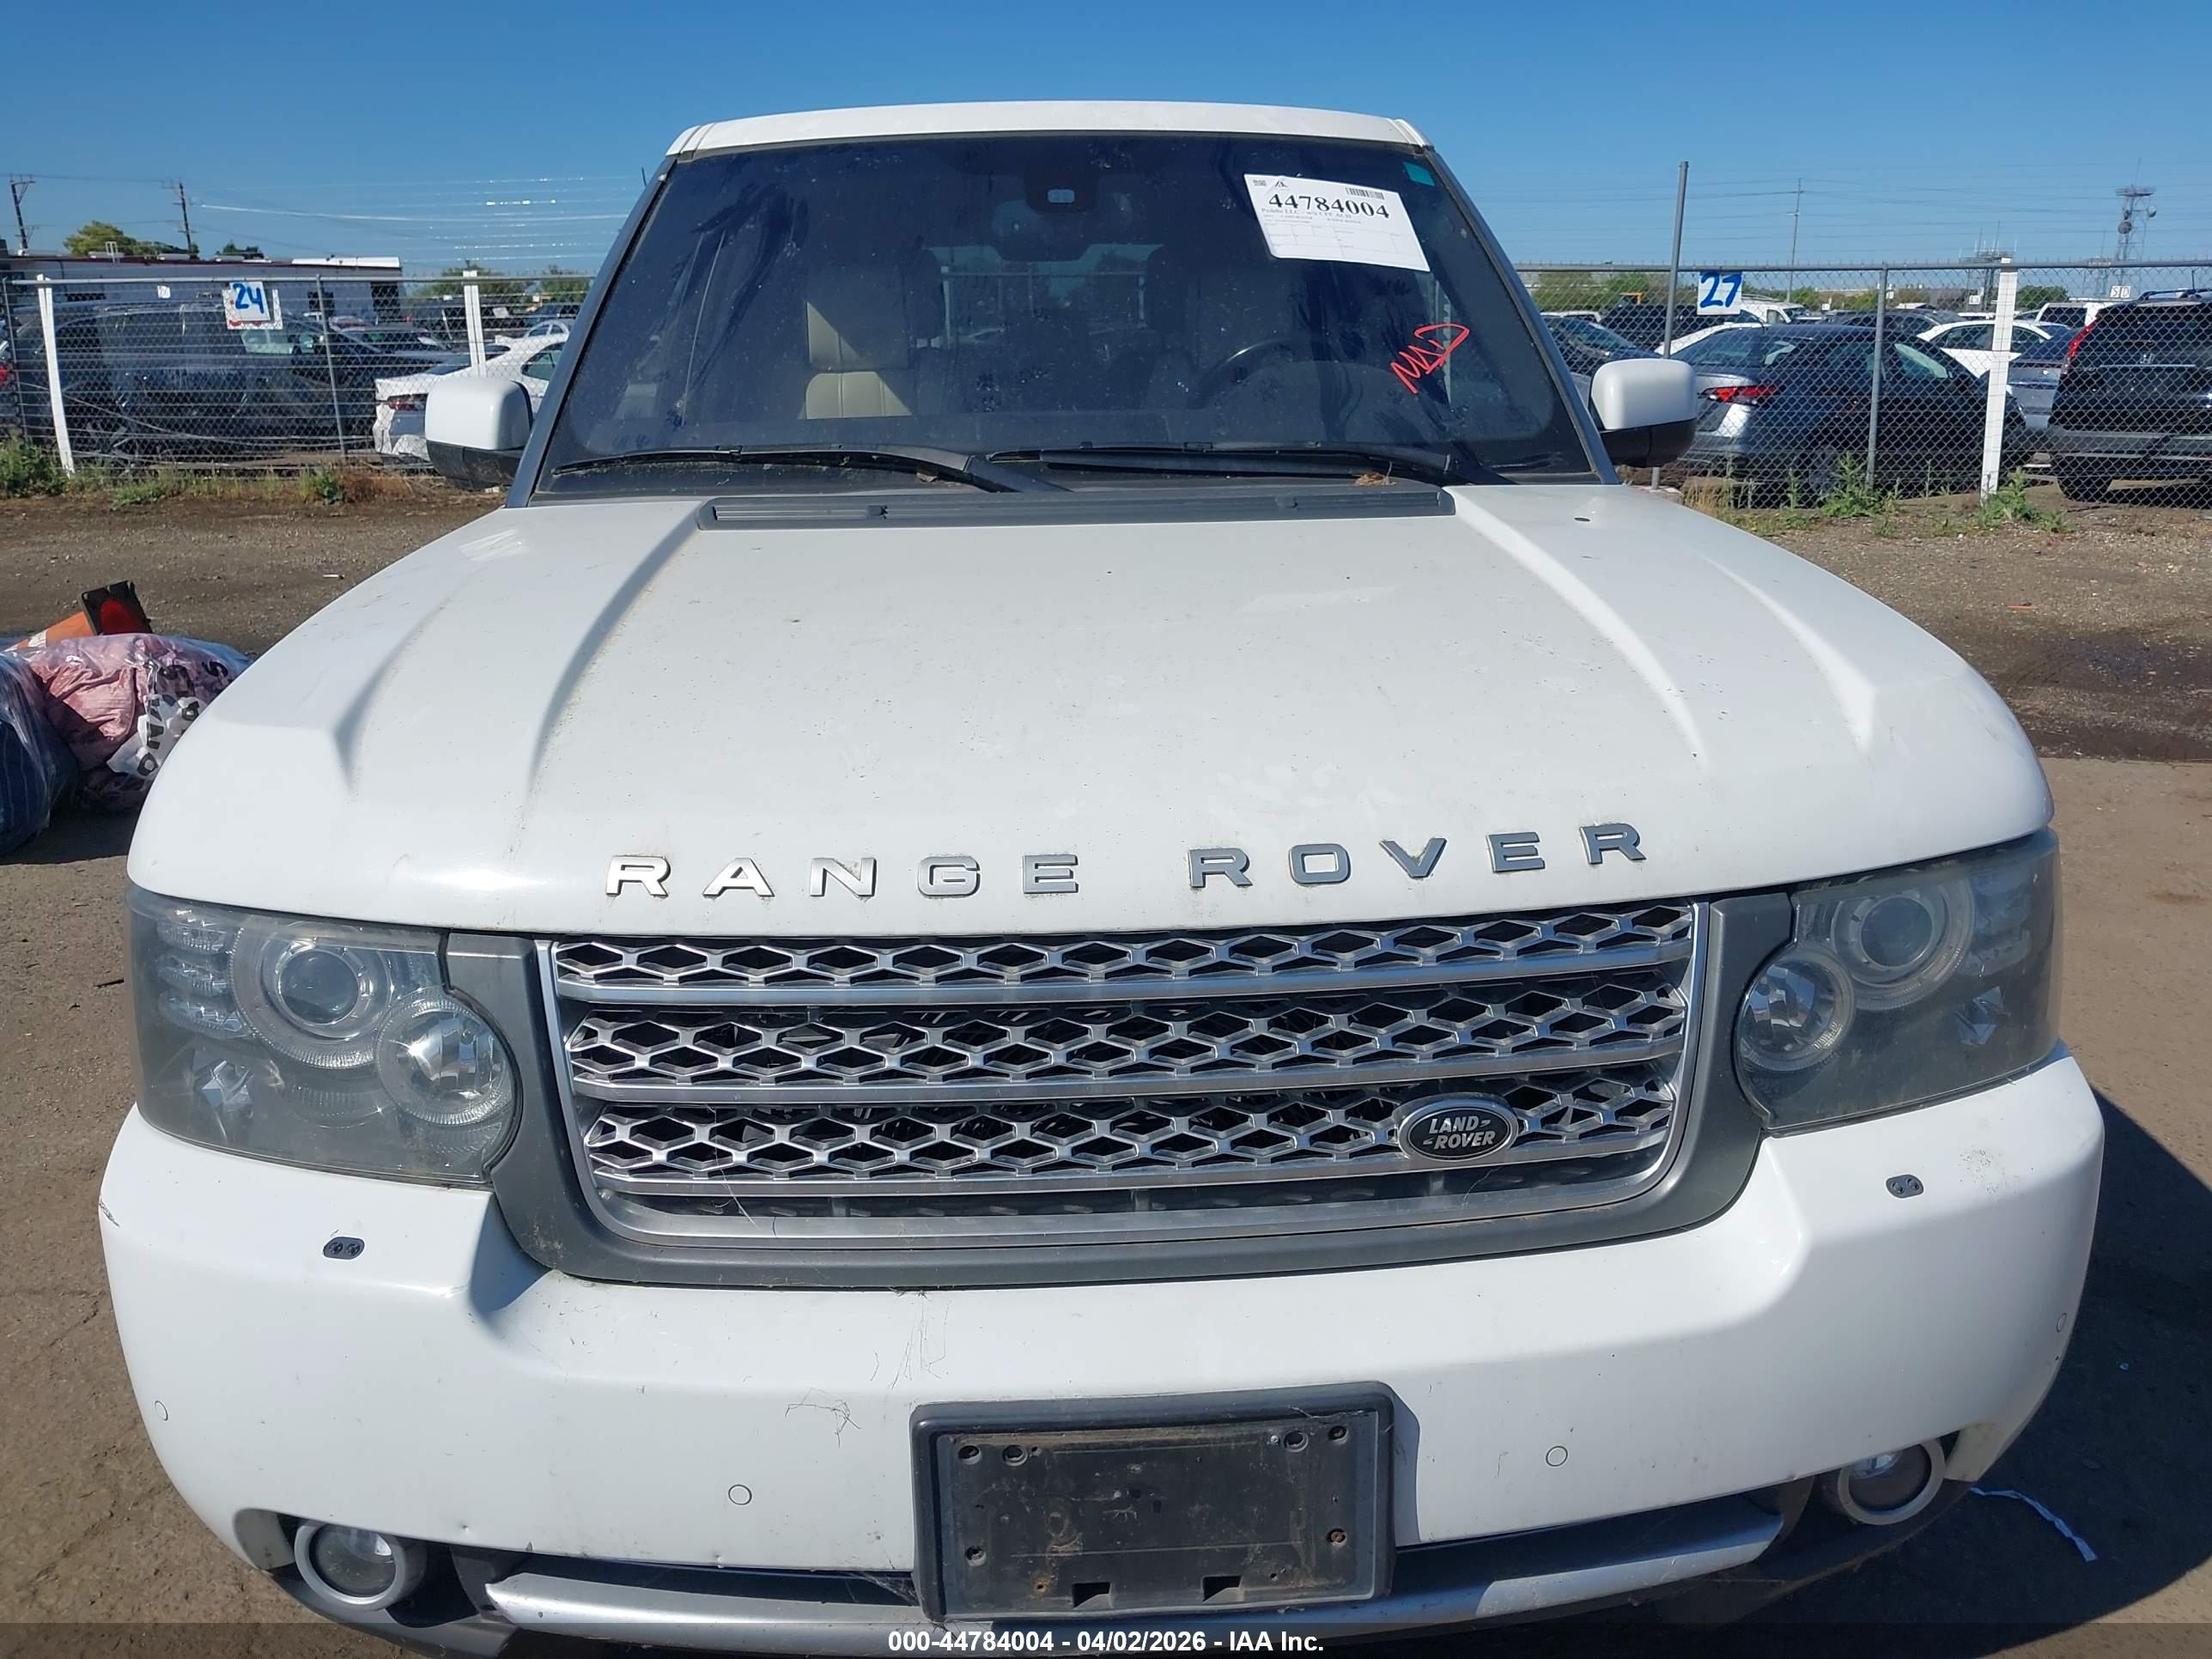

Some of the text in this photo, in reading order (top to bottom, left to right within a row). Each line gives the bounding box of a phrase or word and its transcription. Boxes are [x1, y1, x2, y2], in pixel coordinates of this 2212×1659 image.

[1268, 193, 1390, 219] 44784004
[233, 283, 264, 314] 24
[1700, 271, 1741, 308] 27
[605, 822, 1646, 897] RANGE ROVER
[1429, 1116, 1479, 1133] LAND
[1433, 1130, 1496, 1150] ROVER
